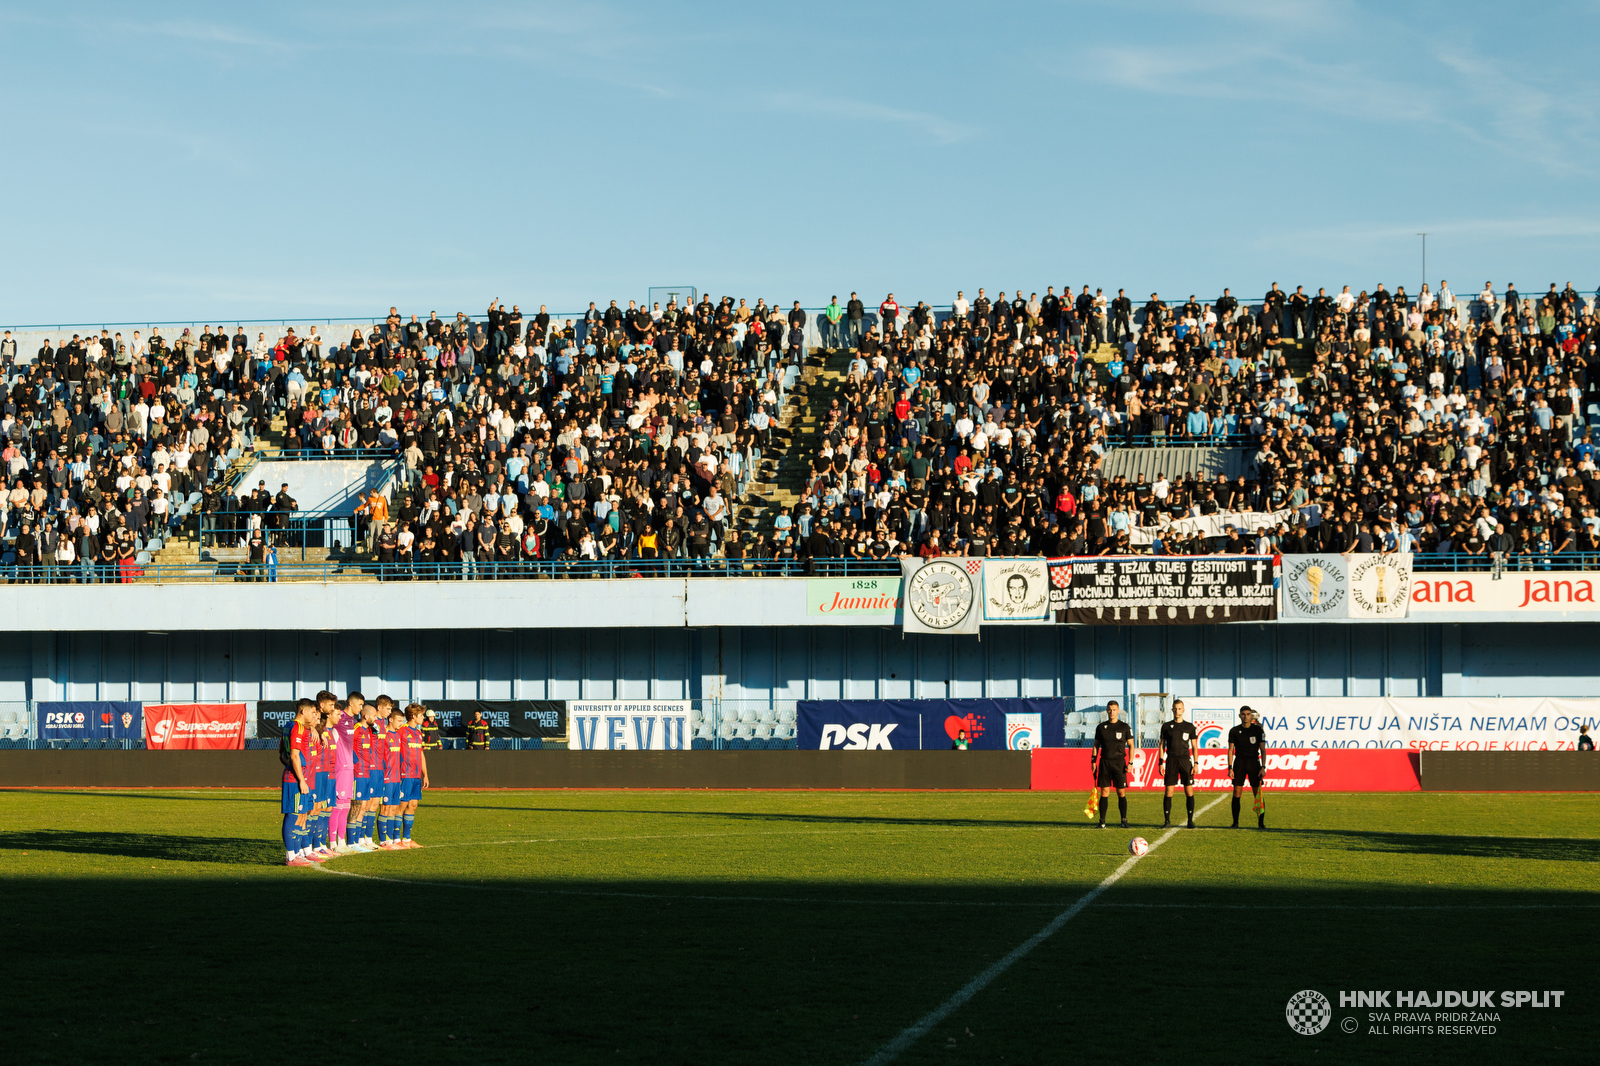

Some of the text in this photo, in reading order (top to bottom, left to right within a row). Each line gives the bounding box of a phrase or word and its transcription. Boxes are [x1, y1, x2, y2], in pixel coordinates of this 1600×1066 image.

[1073, 562, 1098, 575] KOME
[1103, 562, 1115, 574] JE
[1119, 560, 1150, 574] TEŽAK
[852, 580, 877, 589] 1828
[1119, 574, 1132, 586] GA
[1136, 573, 1172, 586] UTAKNE
[1178, 573, 1186, 585] U
[1191, 573, 1228, 585] ZEMLJU
[1049, 588, 1071, 601] GDJE
[1073, 585, 1114, 599] POČIVAJU
[1117, 586, 1154, 598] NJIHOVE
[1157, 586, 1183, 597] KOSTI
[1187, 586, 1203, 597] ONI
[1225, 586, 1238, 597] GA
[1241, 582, 1274, 597] DRŽATI
[819, 591, 904, 613] Jamnica
[573, 704, 612, 712] UNIVERSITY
[46, 712, 75, 724] PSK
[263, 711, 296, 720] POWER
[434, 711, 462, 720] OWER
[481, 711, 510, 720] OWER
[524, 711, 559, 720] POWER
[175, 720, 240, 733] SuperSport
[443, 719, 462, 728] ADE
[491, 719, 510, 728] ADE
[540, 719, 559, 728] ADE
[1261, 716, 1289, 730] NA
[1295, 716, 1372, 730] SVIJETU
[1377, 716, 1401, 730] JA
[1408, 713, 1463, 731] NIŠTA
[1469, 716, 1547, 731] NEMAM
[574, 715, 687, 750] VEVU
[819, 723, 899, 750] PSK
[1293, 778, 1315, 788] KUP
